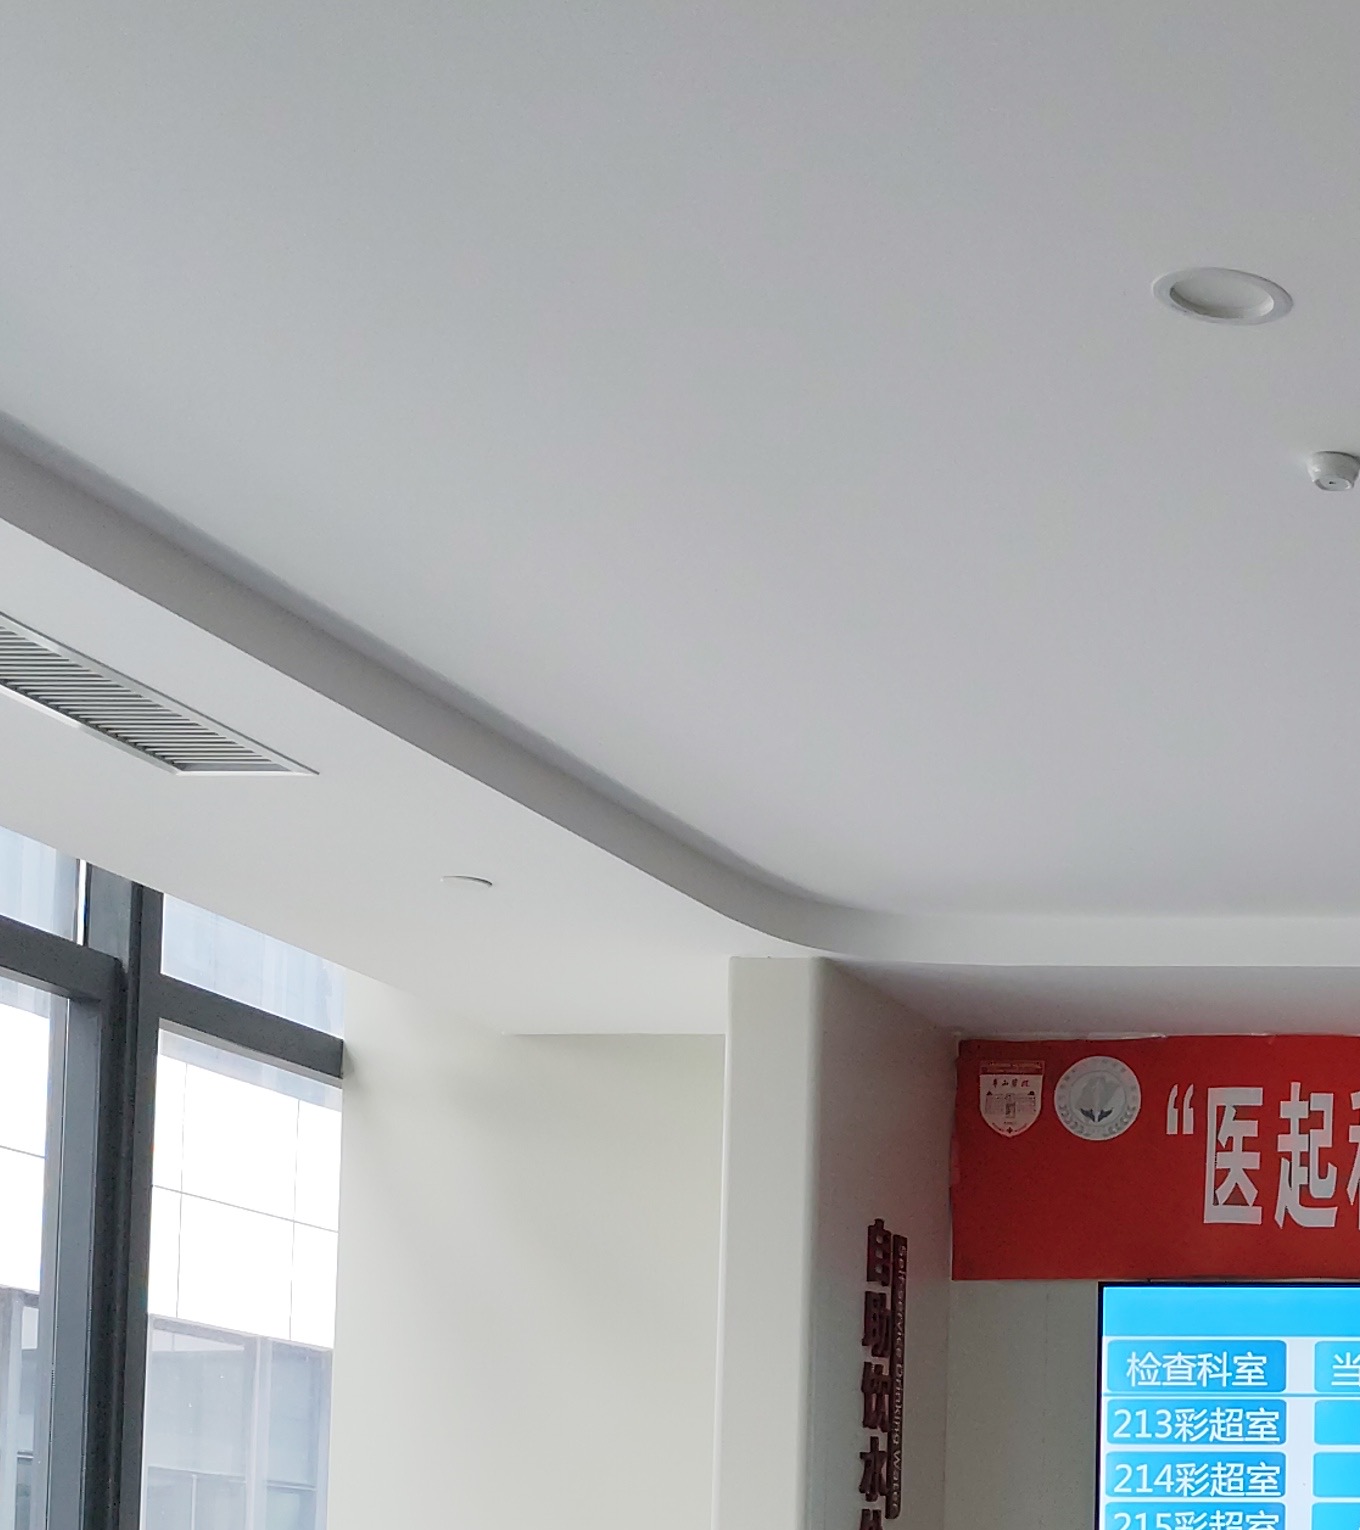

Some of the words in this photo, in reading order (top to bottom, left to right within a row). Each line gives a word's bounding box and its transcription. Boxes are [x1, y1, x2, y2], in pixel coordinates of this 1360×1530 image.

[1126, 1351, 1268, 1388] 检查科室
[1112, 1406, 1281, 1443] 213彩超室
[1113, 1461, 1282, 1498] 214彩超室
